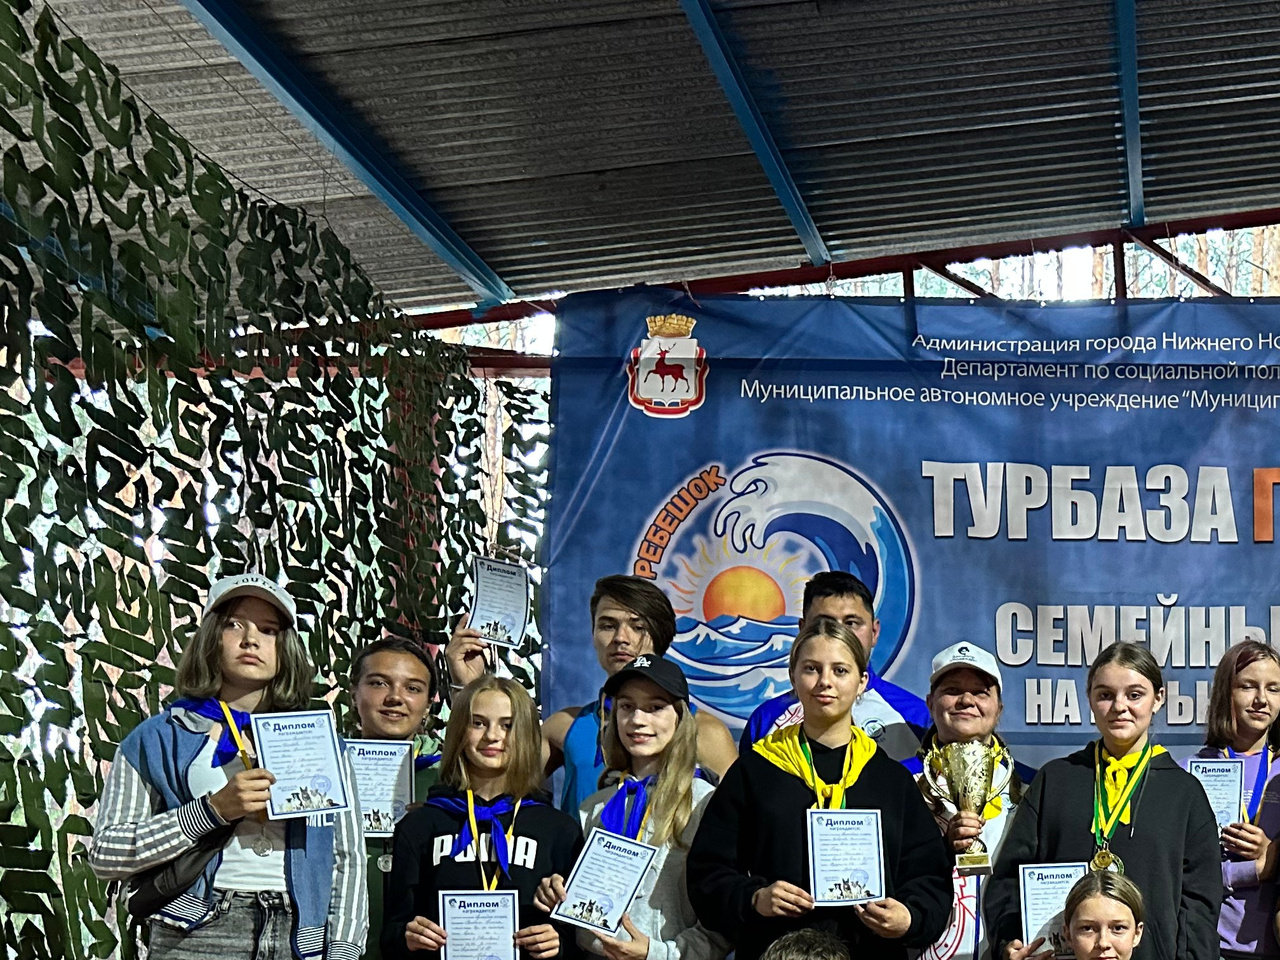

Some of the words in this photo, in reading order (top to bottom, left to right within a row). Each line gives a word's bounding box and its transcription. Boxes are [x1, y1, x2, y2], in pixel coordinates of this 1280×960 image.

[912, 334, 1080, 355] Администрация
[1086, 336, 1157, 353] города
[1162, 332, 1253, 350] Нижнего
[941, 358, 1079, 380] Департамент
[1084, 365, 1109, 379] по
[1114, 361, 1239, 382] социальной
[740, 379, 915, 402] Муниципальное
[920, 388, 1045, 406] автономное
[1050, 391, 1179, 411] учреждение
[921, 460, 1239, 543] ТУРБАЗА
[633, 465, 727, 581] РЕБЕШОК
[486, 564, 517, 576] Диплом
[1025, 678, 1082, 724] НА
[273, 722, 316, 732] Диплом
[357, 748, 397, 757] Диплом
[1201, 766, 1231, 774] Диплом
[825, 818, 864, 827] Диплом
[603, 840, 639, 858] Диплом
[1036, 872, 1073, 881] Диплом
[458, 900, 499, 909] Диплом
